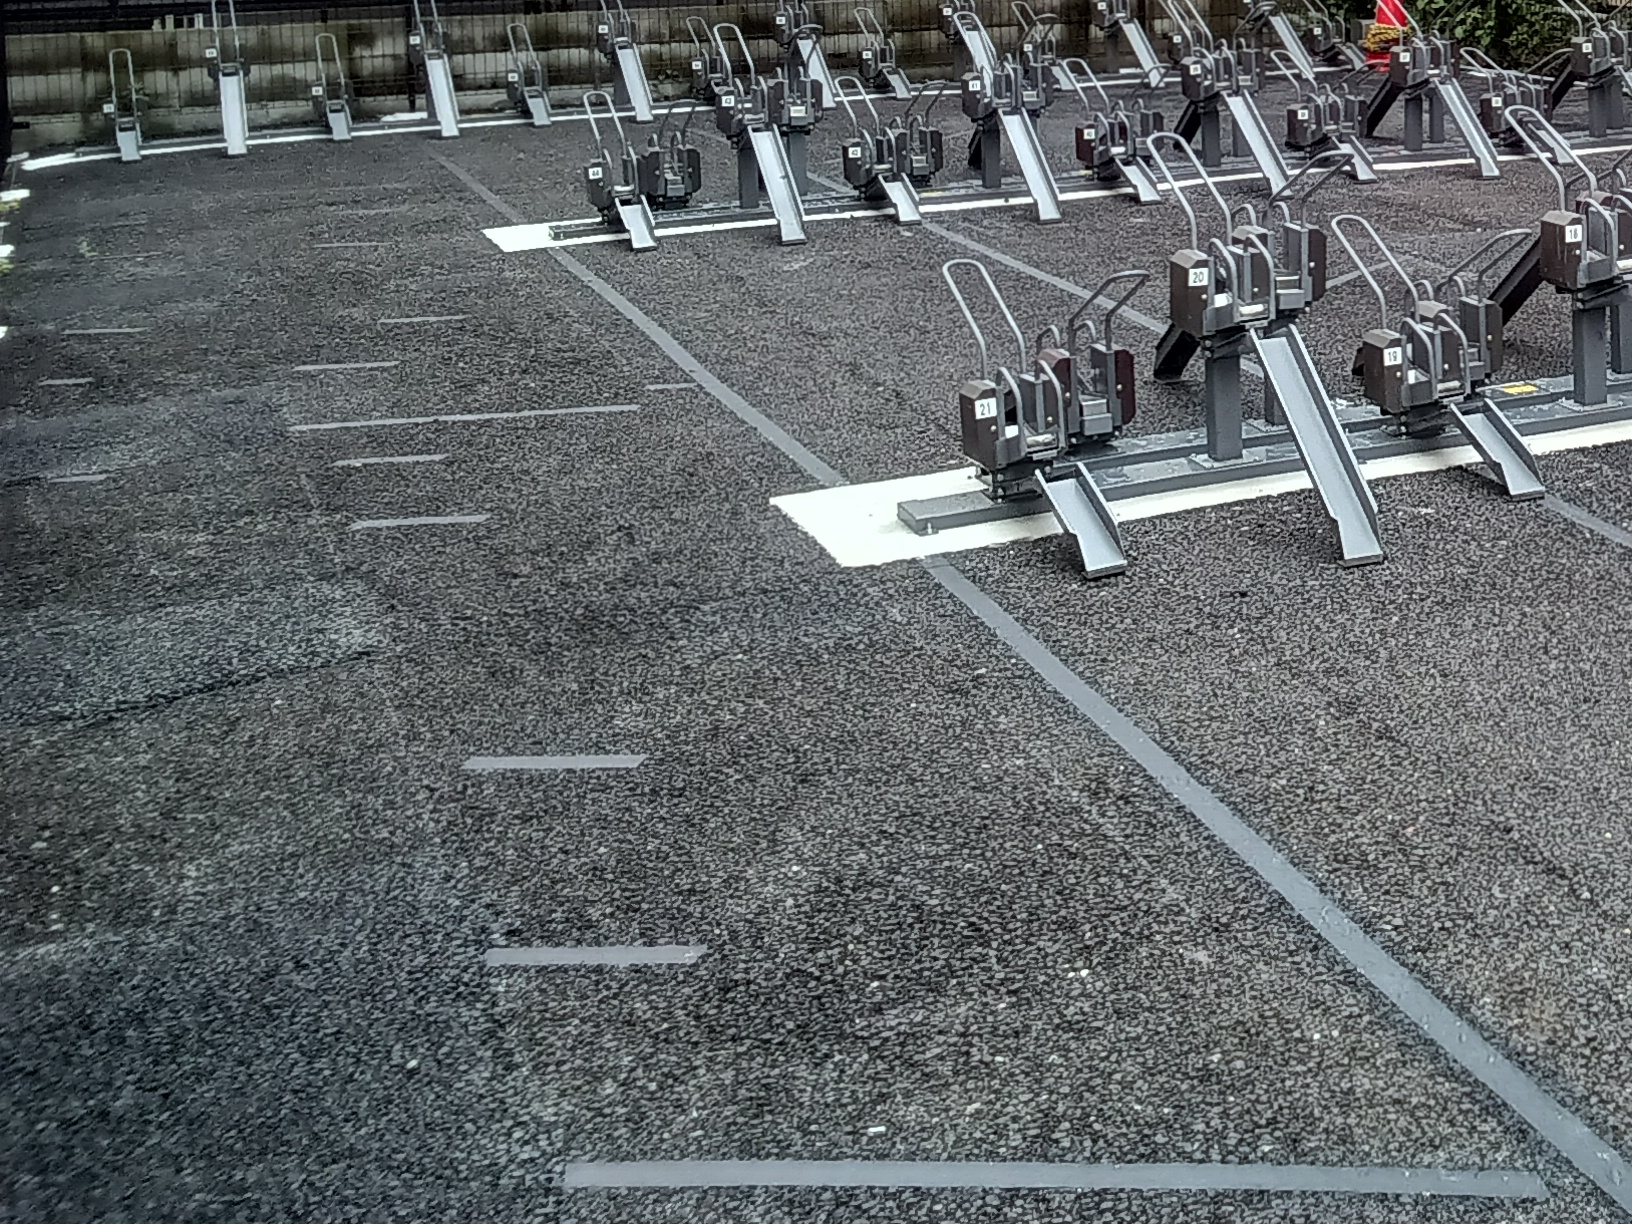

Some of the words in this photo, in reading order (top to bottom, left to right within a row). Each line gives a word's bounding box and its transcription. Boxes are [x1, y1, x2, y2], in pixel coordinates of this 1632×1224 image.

[1192, 271, 1205, 284] 20
[1387, 350, 1398, 364] 19
[979, 403, 992, 416] 21
